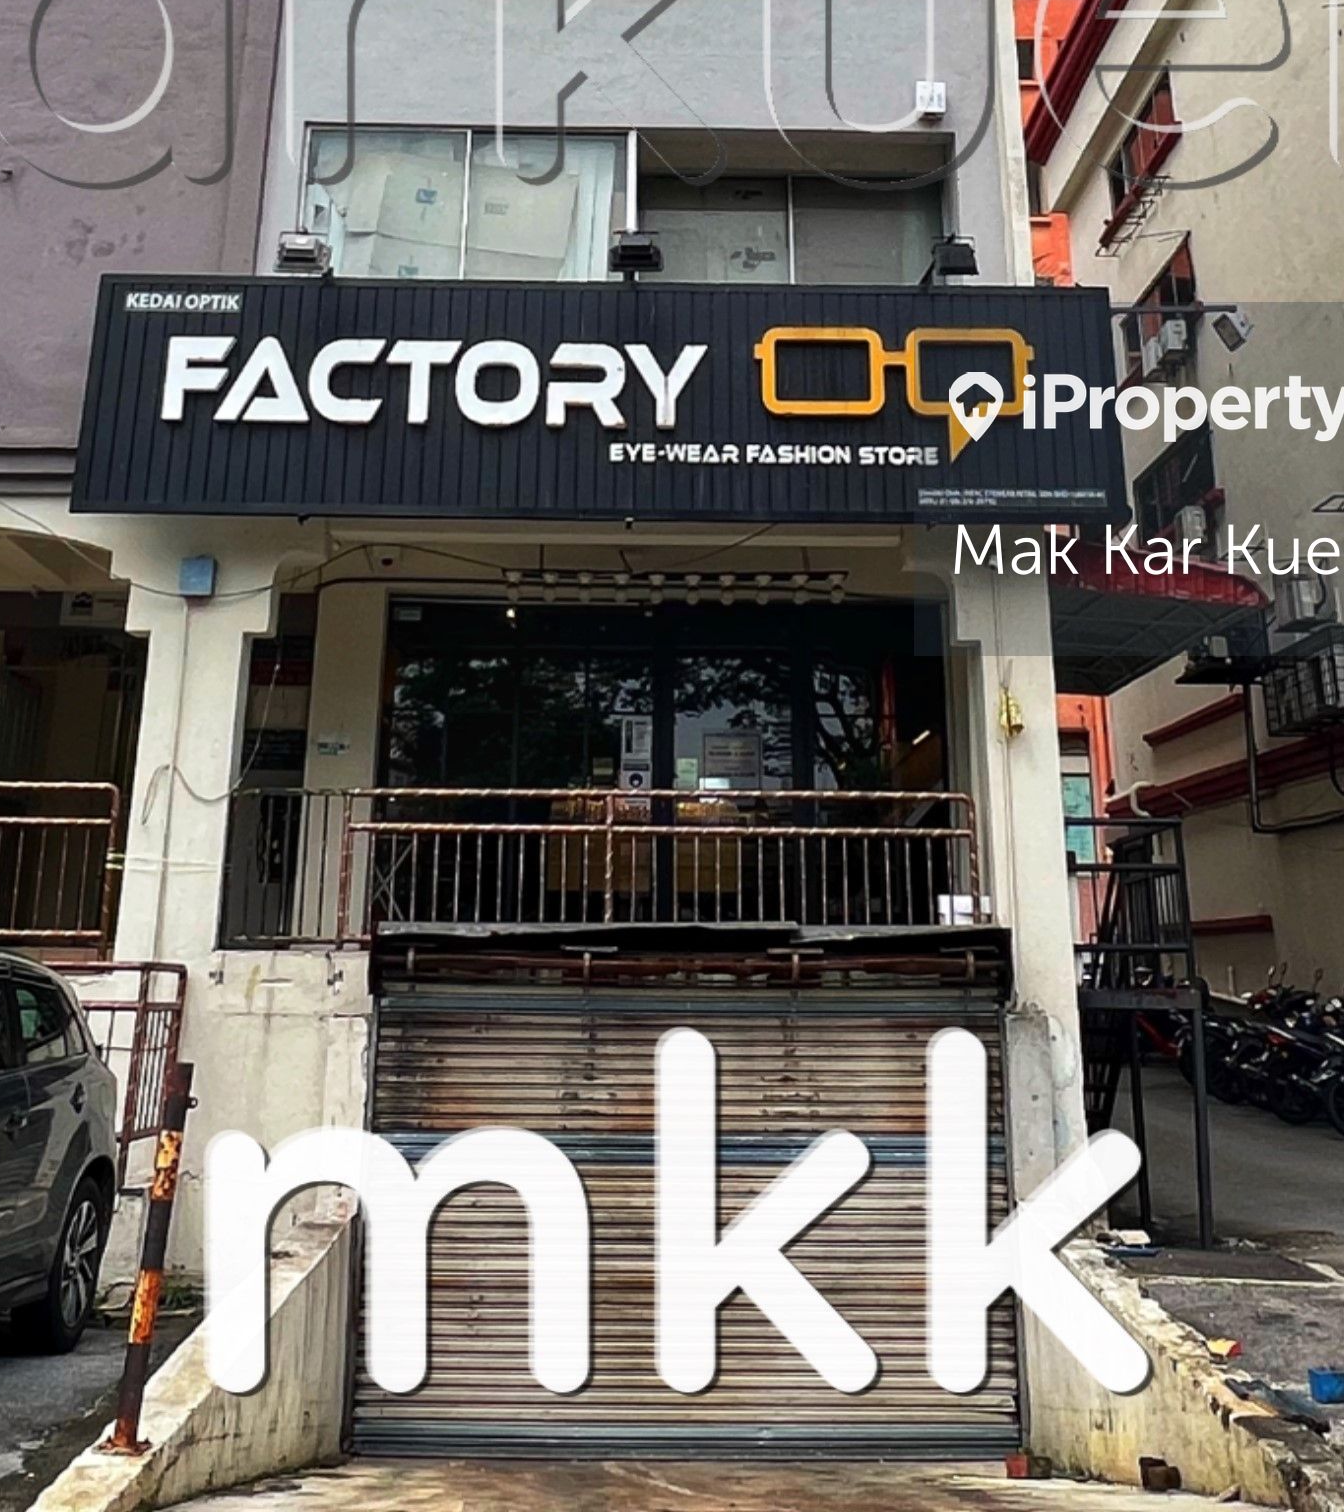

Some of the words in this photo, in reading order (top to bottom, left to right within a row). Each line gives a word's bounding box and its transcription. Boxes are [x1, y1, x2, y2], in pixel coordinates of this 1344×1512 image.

[126, 292, 182, 309] KEDAI
[184, 293, 241, 310] OPTIK
[160, 336, 709, 430] FACTORY
[609, 443, 739, 464] EYE-WEAR
[746, 444, 852, 465] FASHION
[858, 446, 940, 466] STORE
